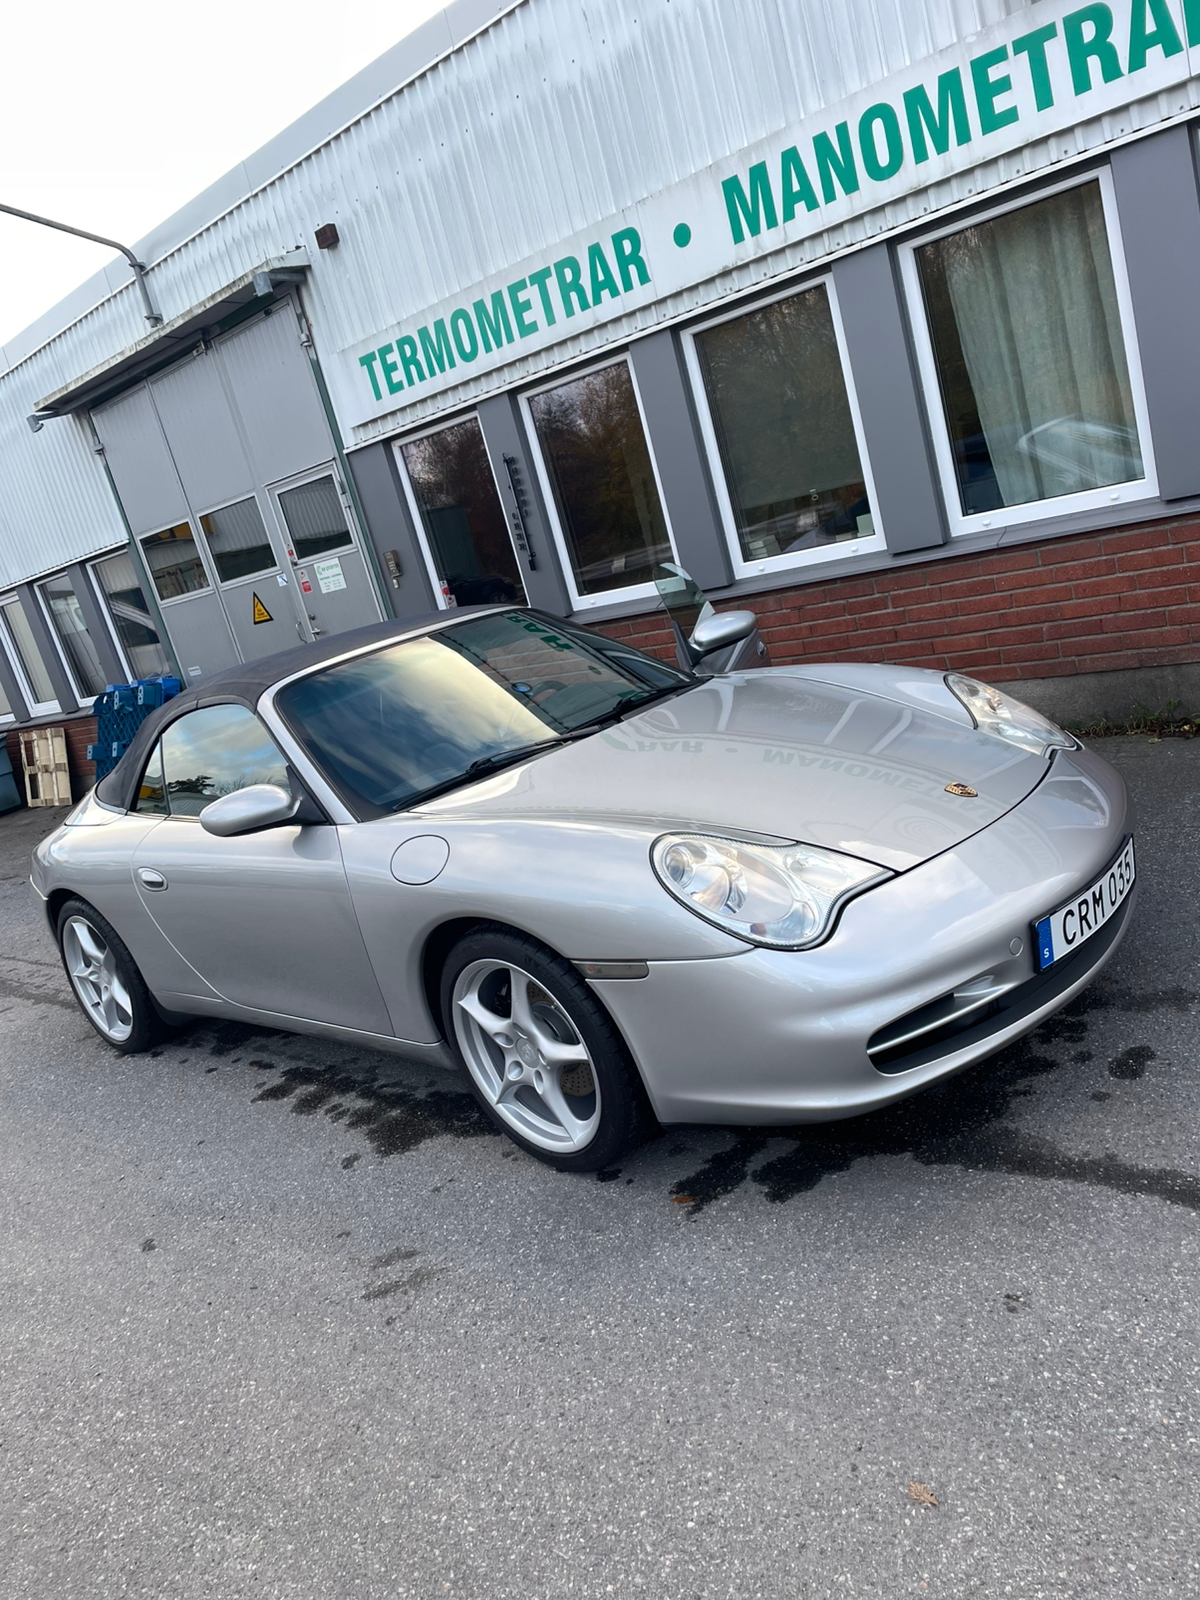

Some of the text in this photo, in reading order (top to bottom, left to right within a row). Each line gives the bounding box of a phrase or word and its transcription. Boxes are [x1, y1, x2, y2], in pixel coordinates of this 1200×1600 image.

[359, 0, 1200, 401] TERMOMETRAR MANOMETRA
[1062, 850, 1131, 945] CRM 035
[1043, 948, 1050, 958] S
